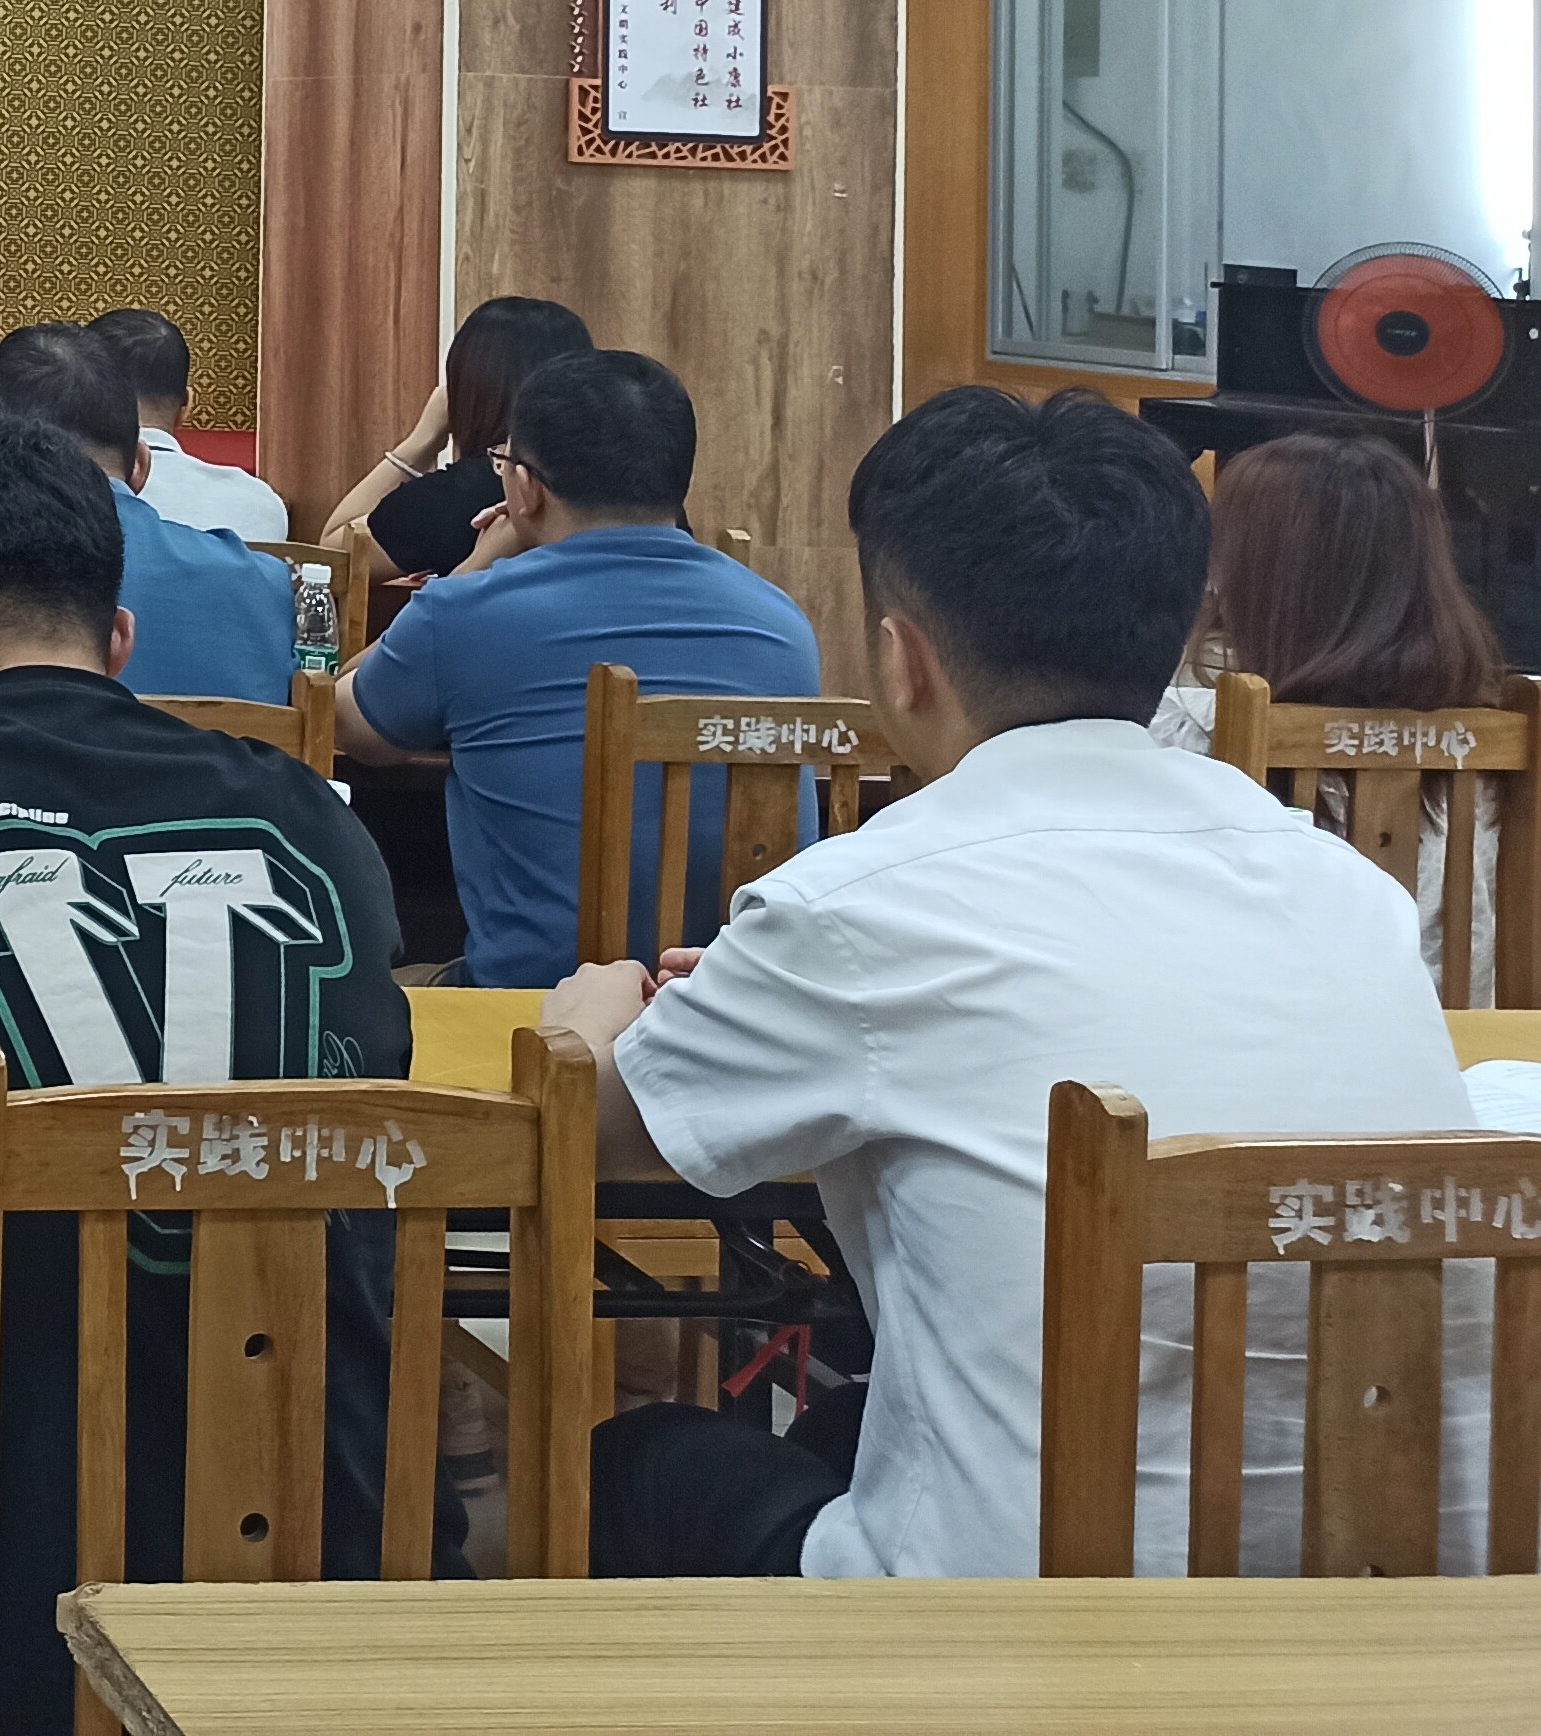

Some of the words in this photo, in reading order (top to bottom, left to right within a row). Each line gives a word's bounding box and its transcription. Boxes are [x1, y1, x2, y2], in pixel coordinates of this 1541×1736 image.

[695, 715, 860, 756] 实践中心
[1322, 719, 1476, 770] 实践中心
[160, 858, 244, 899] future
[119, 1108, 427, 1208] 实践中心
